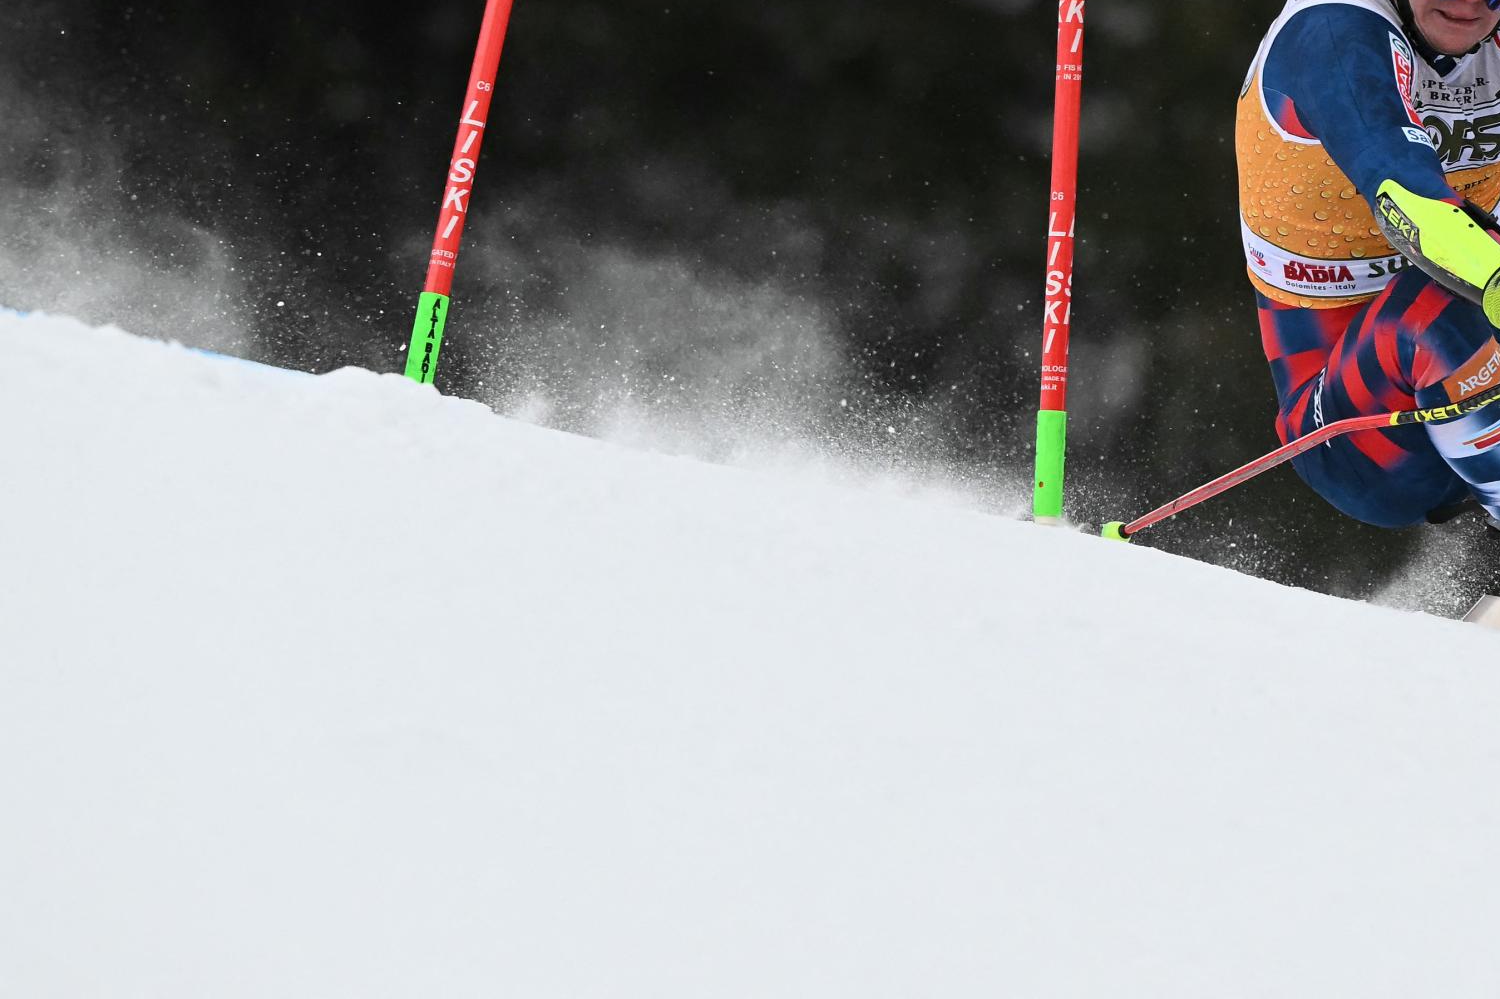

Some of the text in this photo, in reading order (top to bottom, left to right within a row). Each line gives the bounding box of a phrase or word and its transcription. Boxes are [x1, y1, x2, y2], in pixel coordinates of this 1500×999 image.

[477, 81, 490, 91] C6
[442, 100, 484, 239] LISKI
[1380, 196, 1415, 243] LEKI
[1044, 212, 1066, 354] LISKI
[1286, 281, 1327, 290] Dolomites
